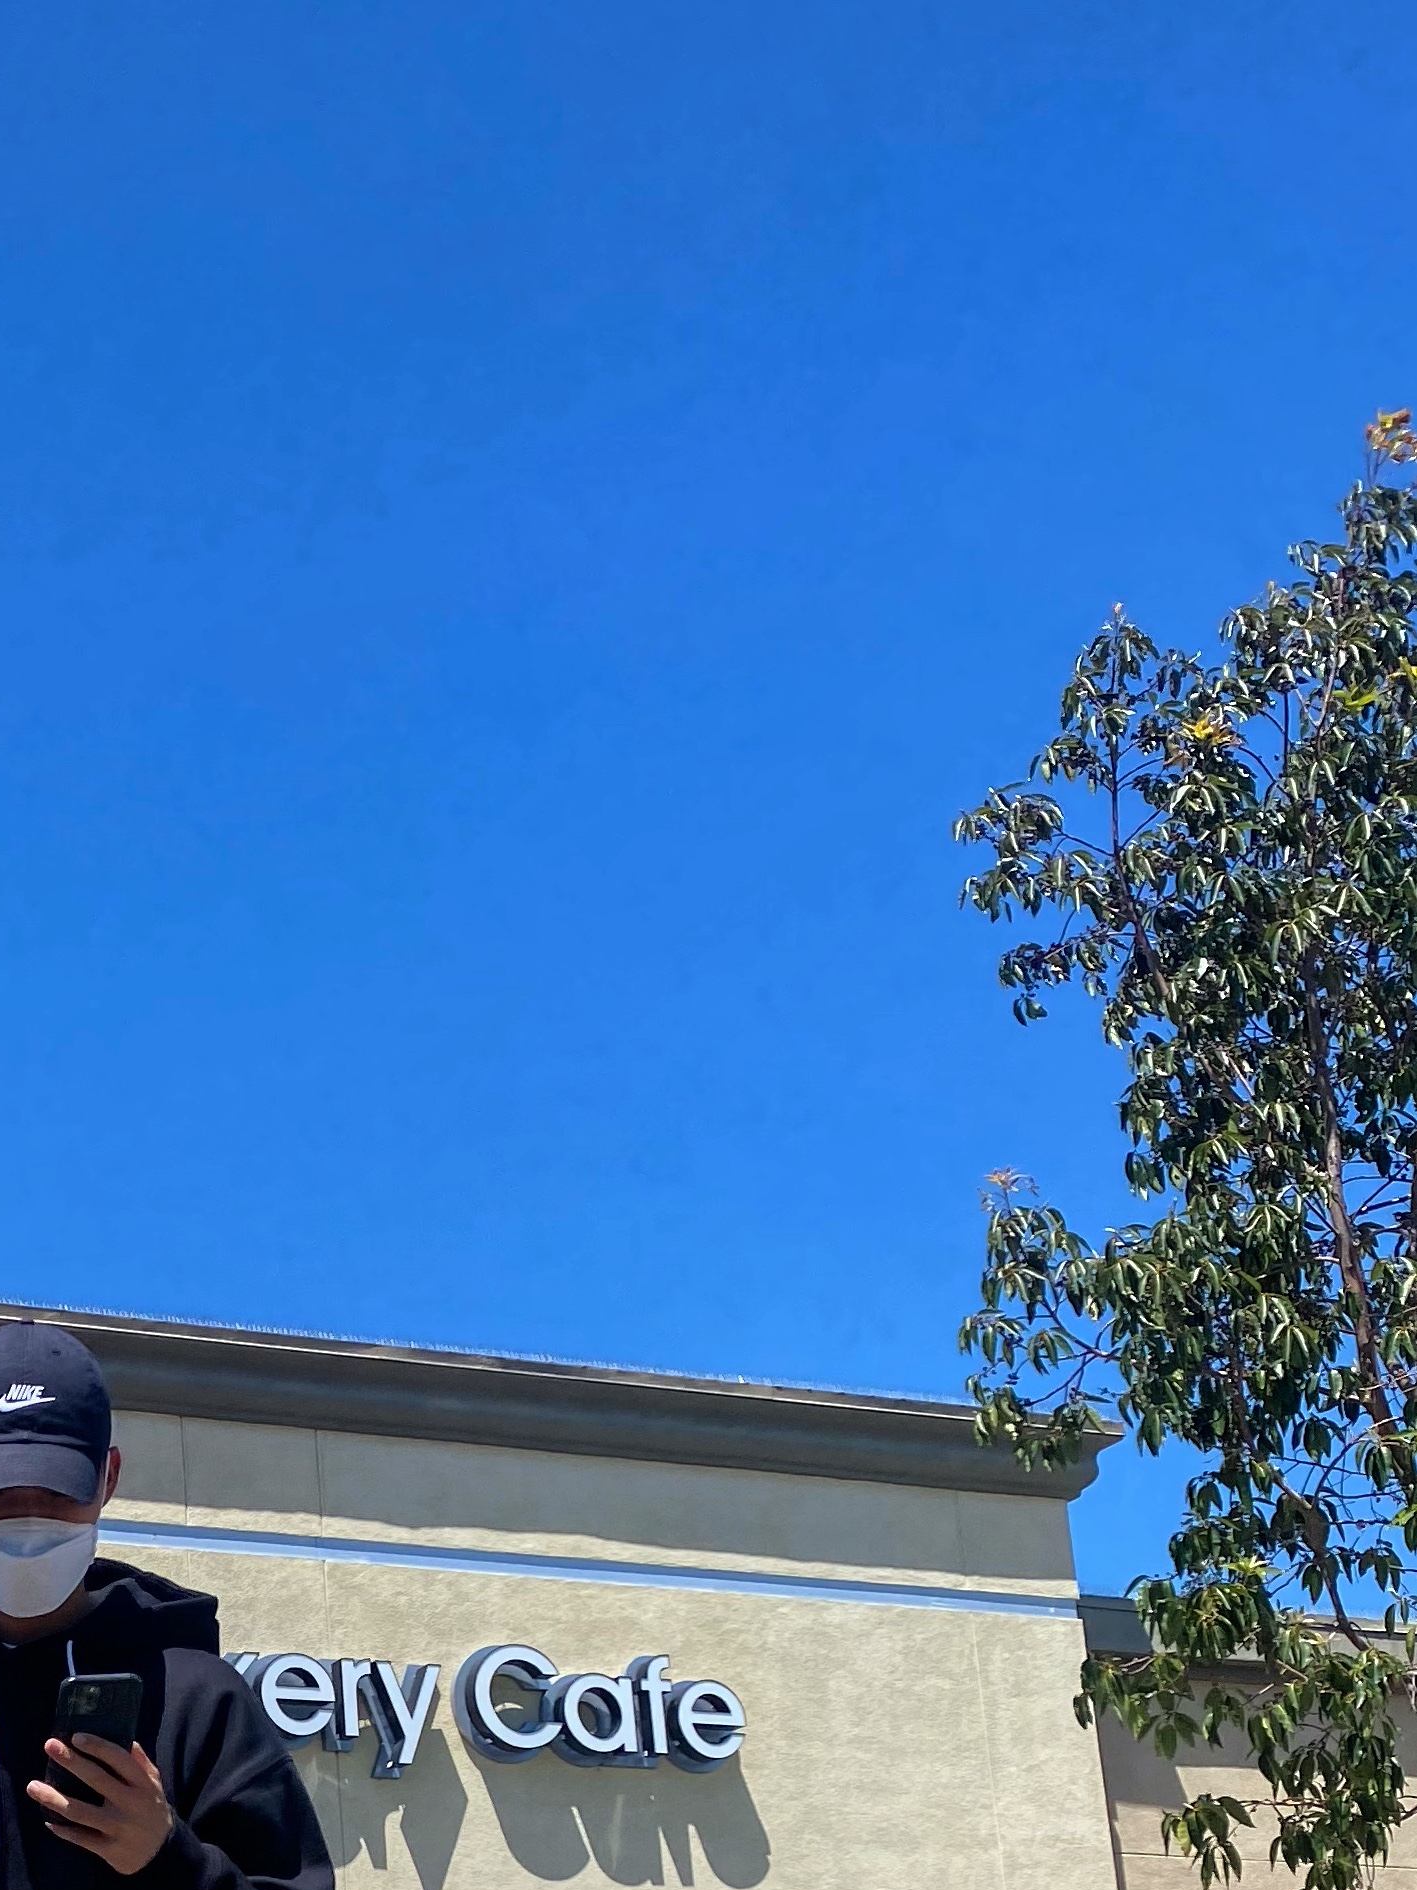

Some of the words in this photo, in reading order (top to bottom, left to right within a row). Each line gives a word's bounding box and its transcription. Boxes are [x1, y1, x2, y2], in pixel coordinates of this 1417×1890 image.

[6, 1383, 45, 1401] NIKE
[229, 1651, 441, 1776] ery
[452, 1643, 746, 1772] Cafe
